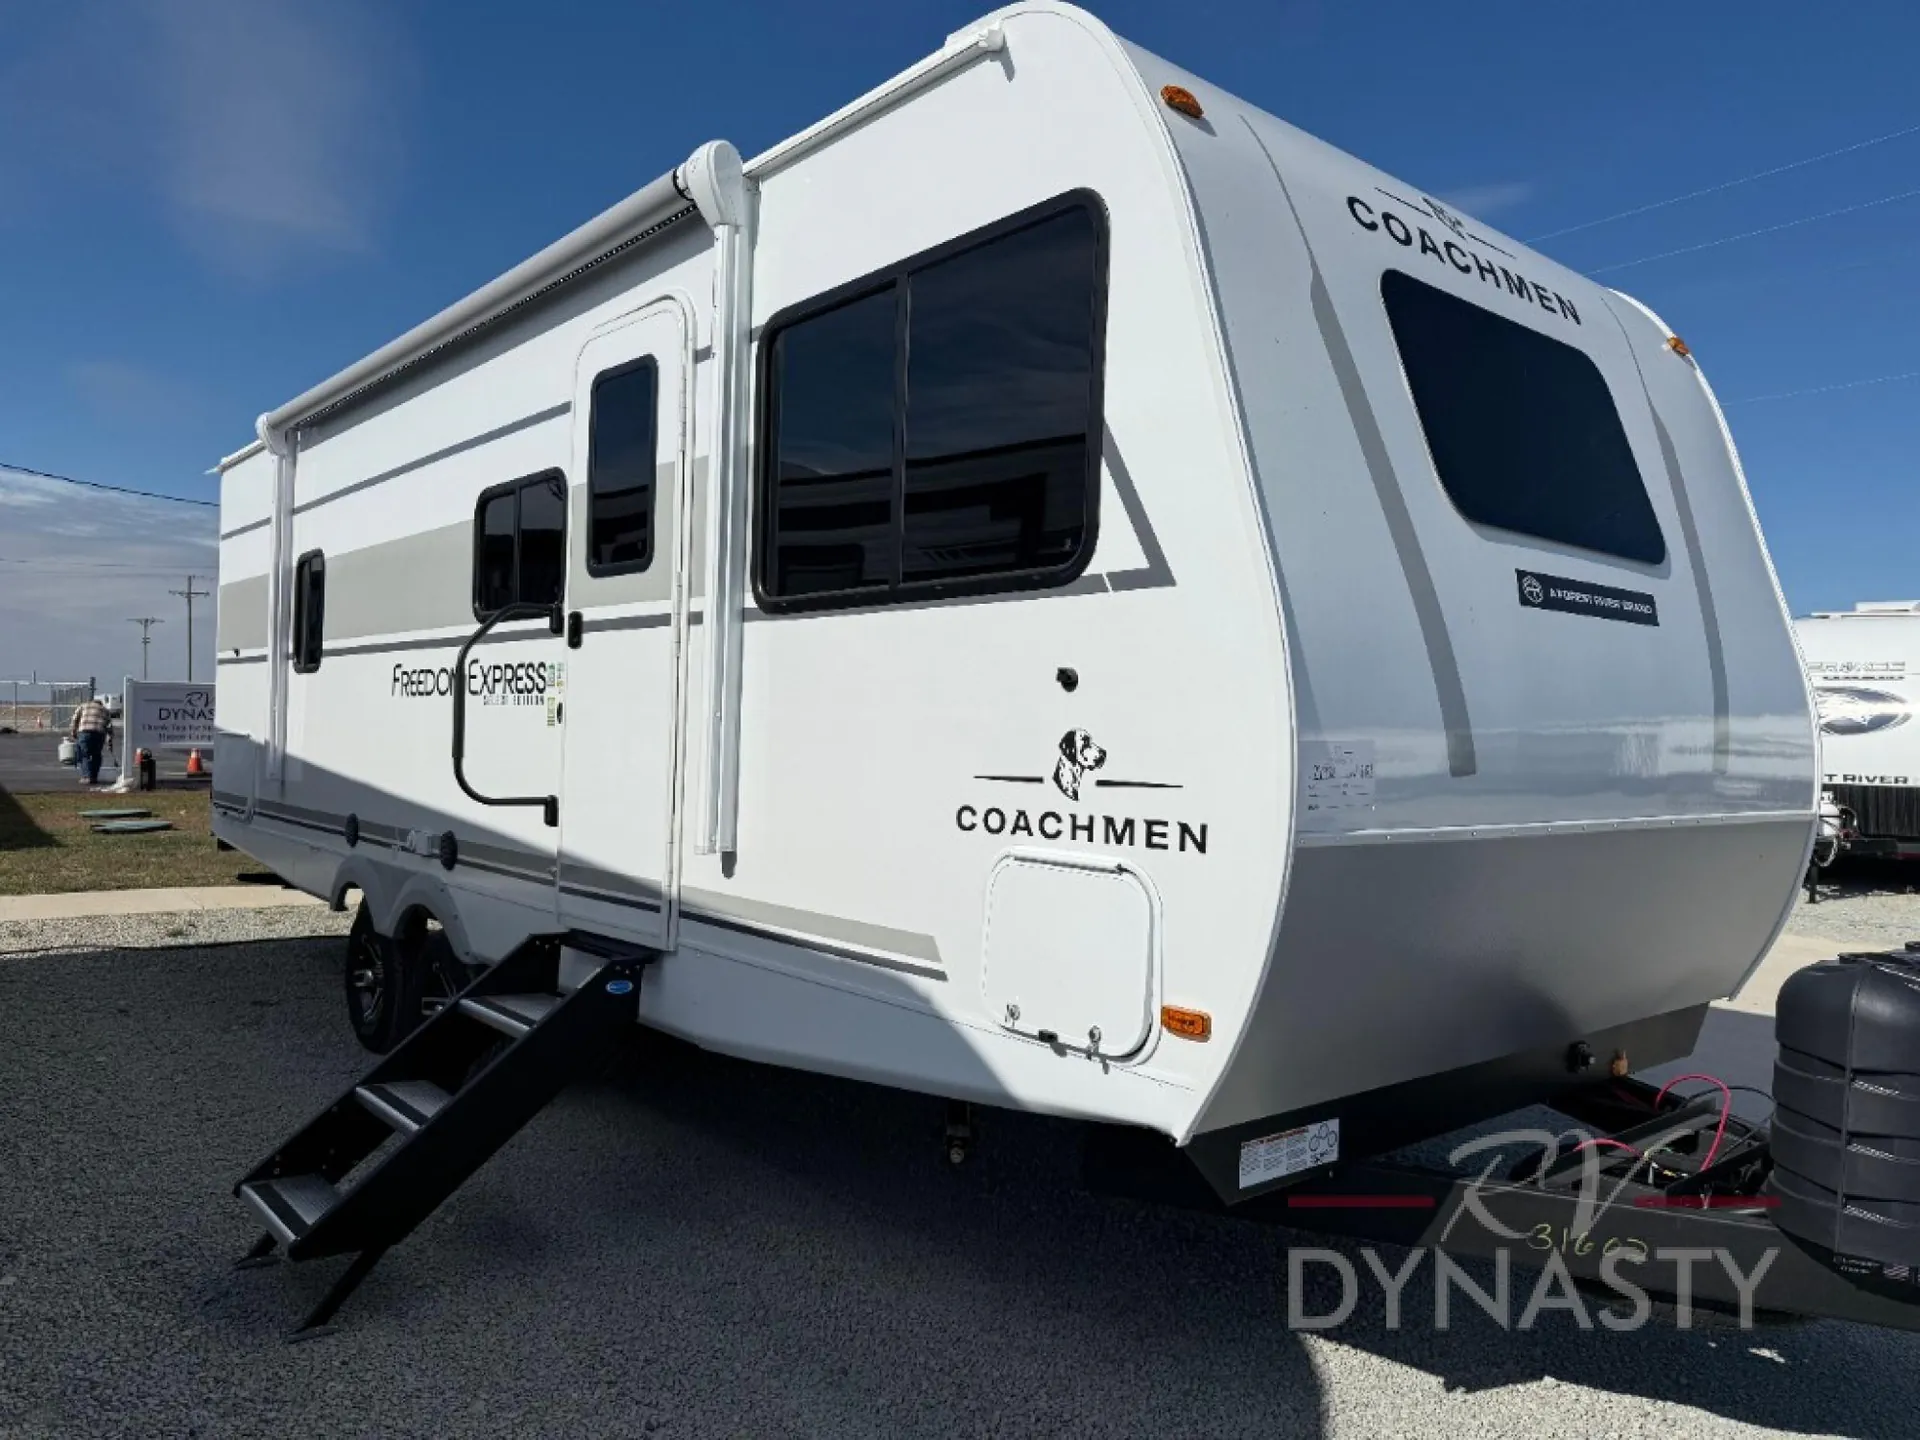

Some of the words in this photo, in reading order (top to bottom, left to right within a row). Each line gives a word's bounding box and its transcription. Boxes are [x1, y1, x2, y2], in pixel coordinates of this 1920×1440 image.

[1346, 196, 1581, 326] COACHMEN
[468, 658, 547, 695] EXPRESS
[158, 708, 214, 721] DYNAS
[1842, 774, 1909, 784] RIVER
[956, 804, 1208, 854] COACHMEN
